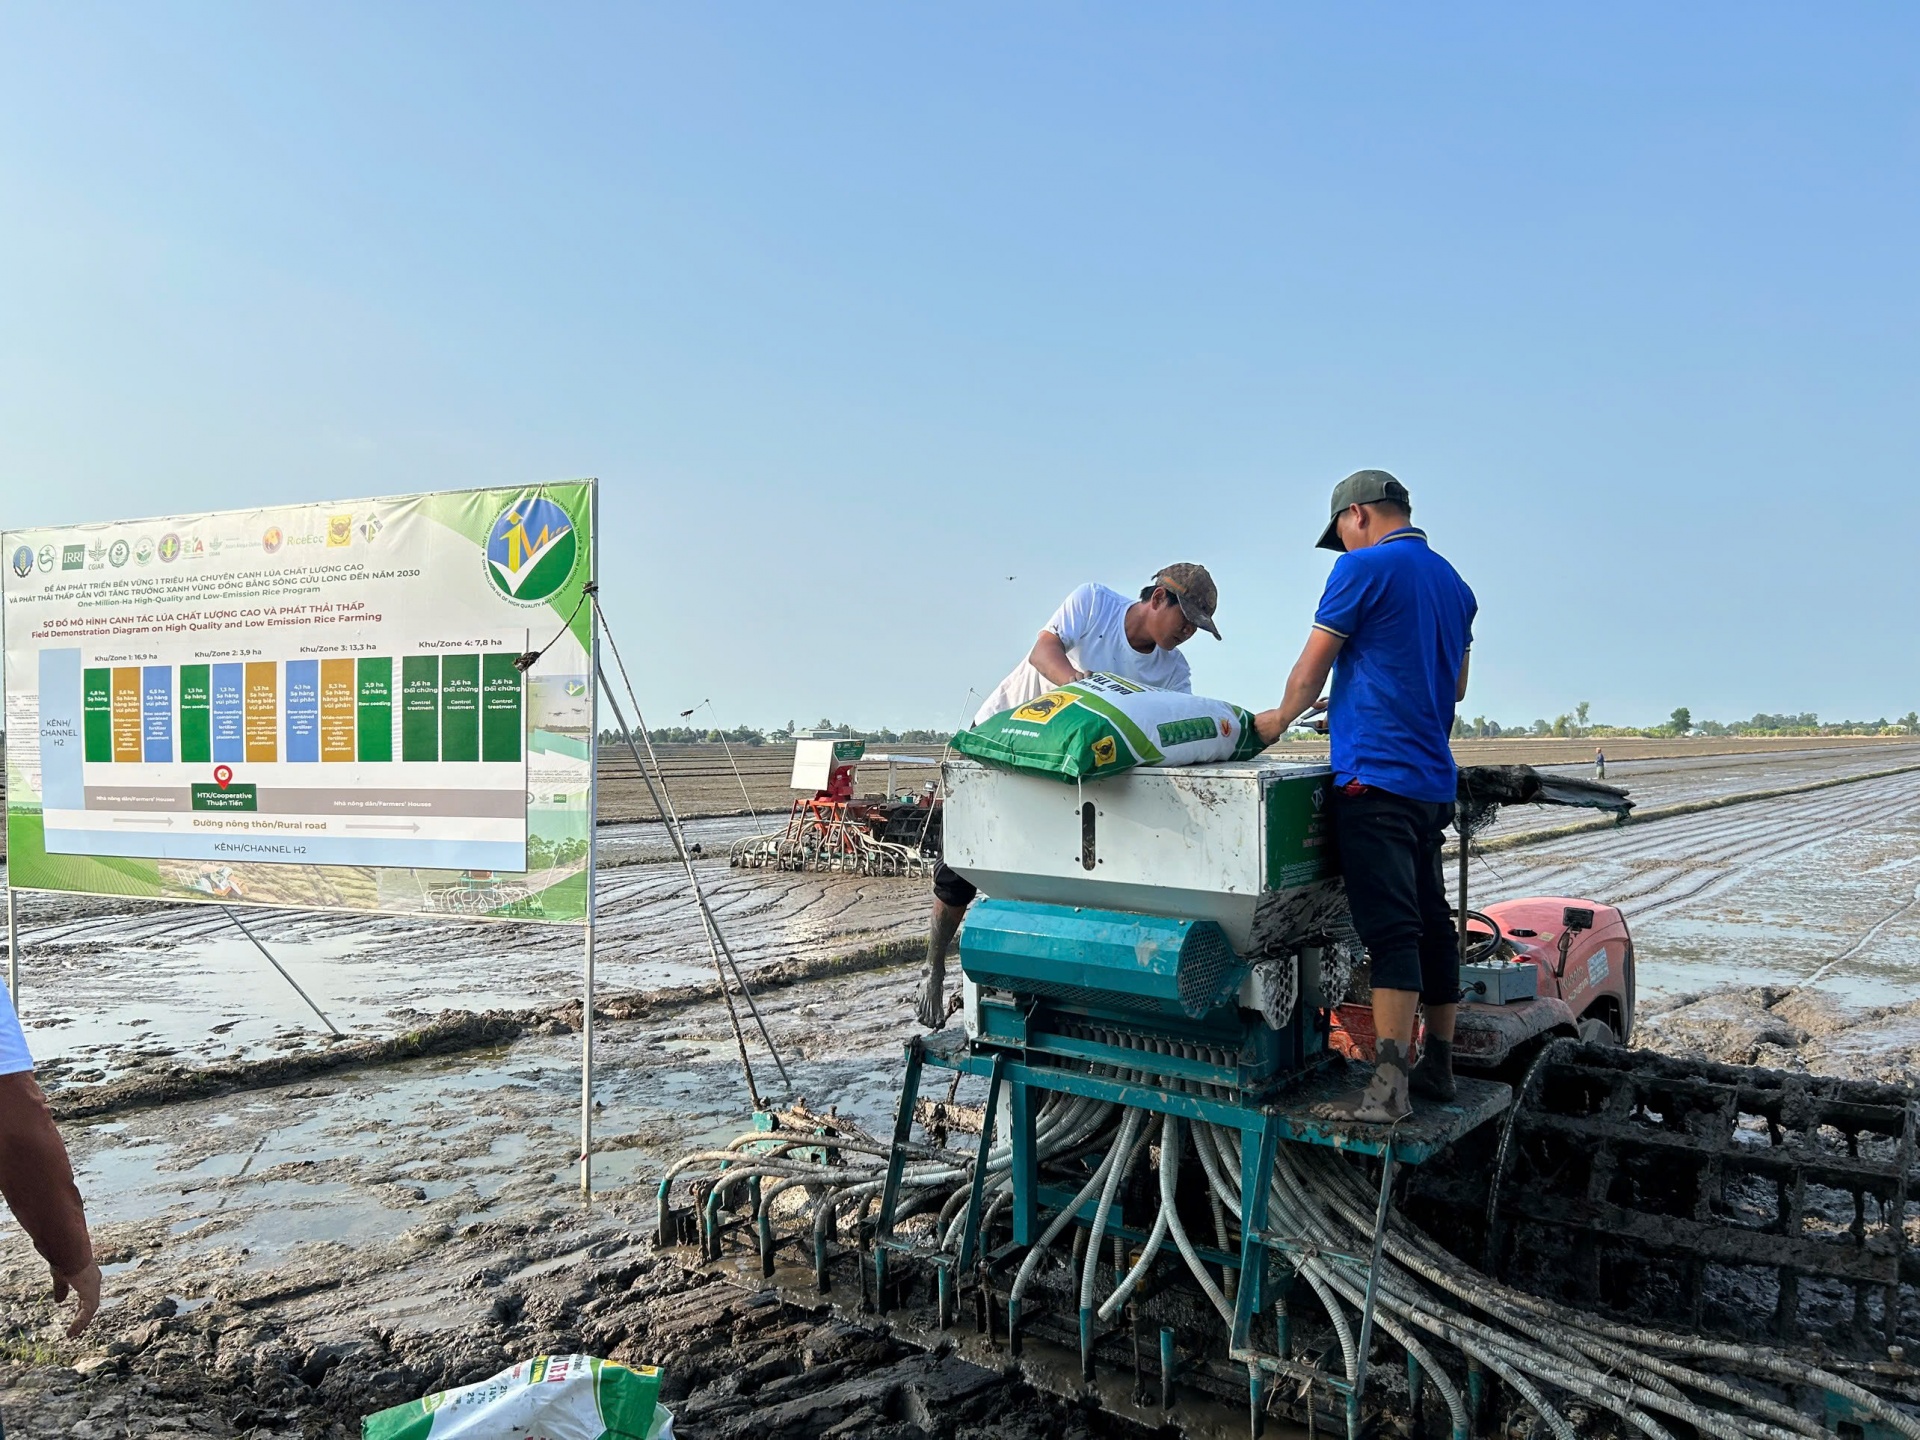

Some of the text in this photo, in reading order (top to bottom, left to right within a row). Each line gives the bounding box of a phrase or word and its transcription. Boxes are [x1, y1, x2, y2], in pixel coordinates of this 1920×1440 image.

[64, 551, 83, 564] IRRI
[134, 596, 183, 604] High-Quality
[203, 591, 260, 599] Low-Emission
[283, 586, 320, 595] Program
[56, 618, 68, 627] ĐỒ
[70, 618, 83, 626] MÔ
[86, 617, 107, 625] HÌNH
[136, 614, 154, 623] TÁC
[156, 613, 174, 622] LÚA
[176, 611, 201, 620] CHẤT
[204, 610, 237, 619] LƯỢNG
[264, 607, 277, 615] VÀ
[280, 605, 307, 614] PHÁT
[309, 603, 333, 612] THẢI
[336, 602, 364, 611] THẤP
[51, 628, 110, 636] Demonstration
[113, 626, 149, 635] Diagram
[166, 623, 186, 633] High
[189, 622, 222, 631] Quality
[268, 617, 311, 625] Emission
[339, 613, 382, 623] Farming
[47, 719, 71, 727] KÊNH/
[193, 819, 223, 828] Đường
[226, 820, 249, 829] nông
[252, 820, 302, 829] thôn/Rural
[215, 843, 291, 853] KÊNH/CHANNEL
[466, 1392, 474, 1404] 2%
[477, 1391, 485, 1404] 7%
